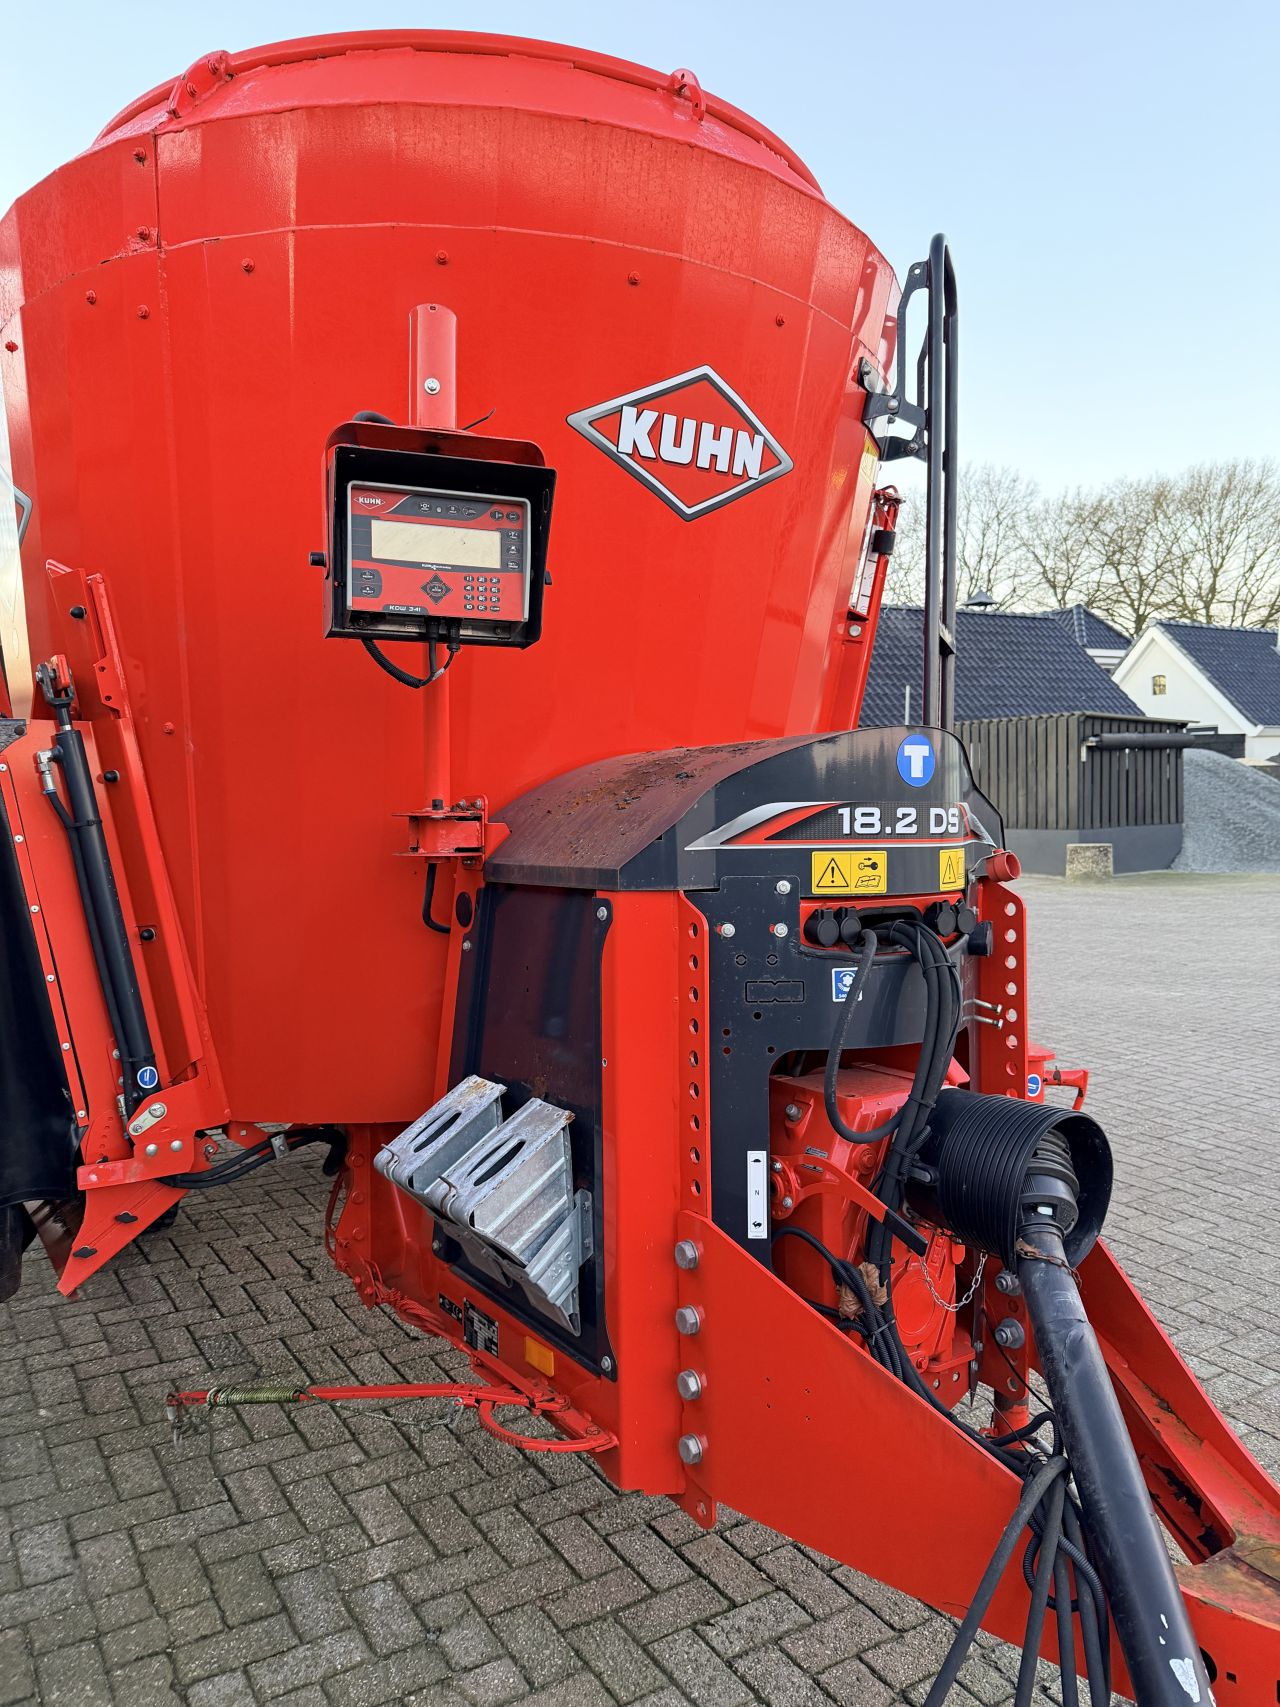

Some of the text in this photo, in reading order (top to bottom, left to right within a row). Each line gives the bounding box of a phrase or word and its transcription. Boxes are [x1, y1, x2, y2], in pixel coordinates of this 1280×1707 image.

[617, 405, 764, 480] KUHN
[358, 496, 382, 506] KUHN
[904, 745, 929, 778] T
[837, 807, 959, 834] 18.2 DS
